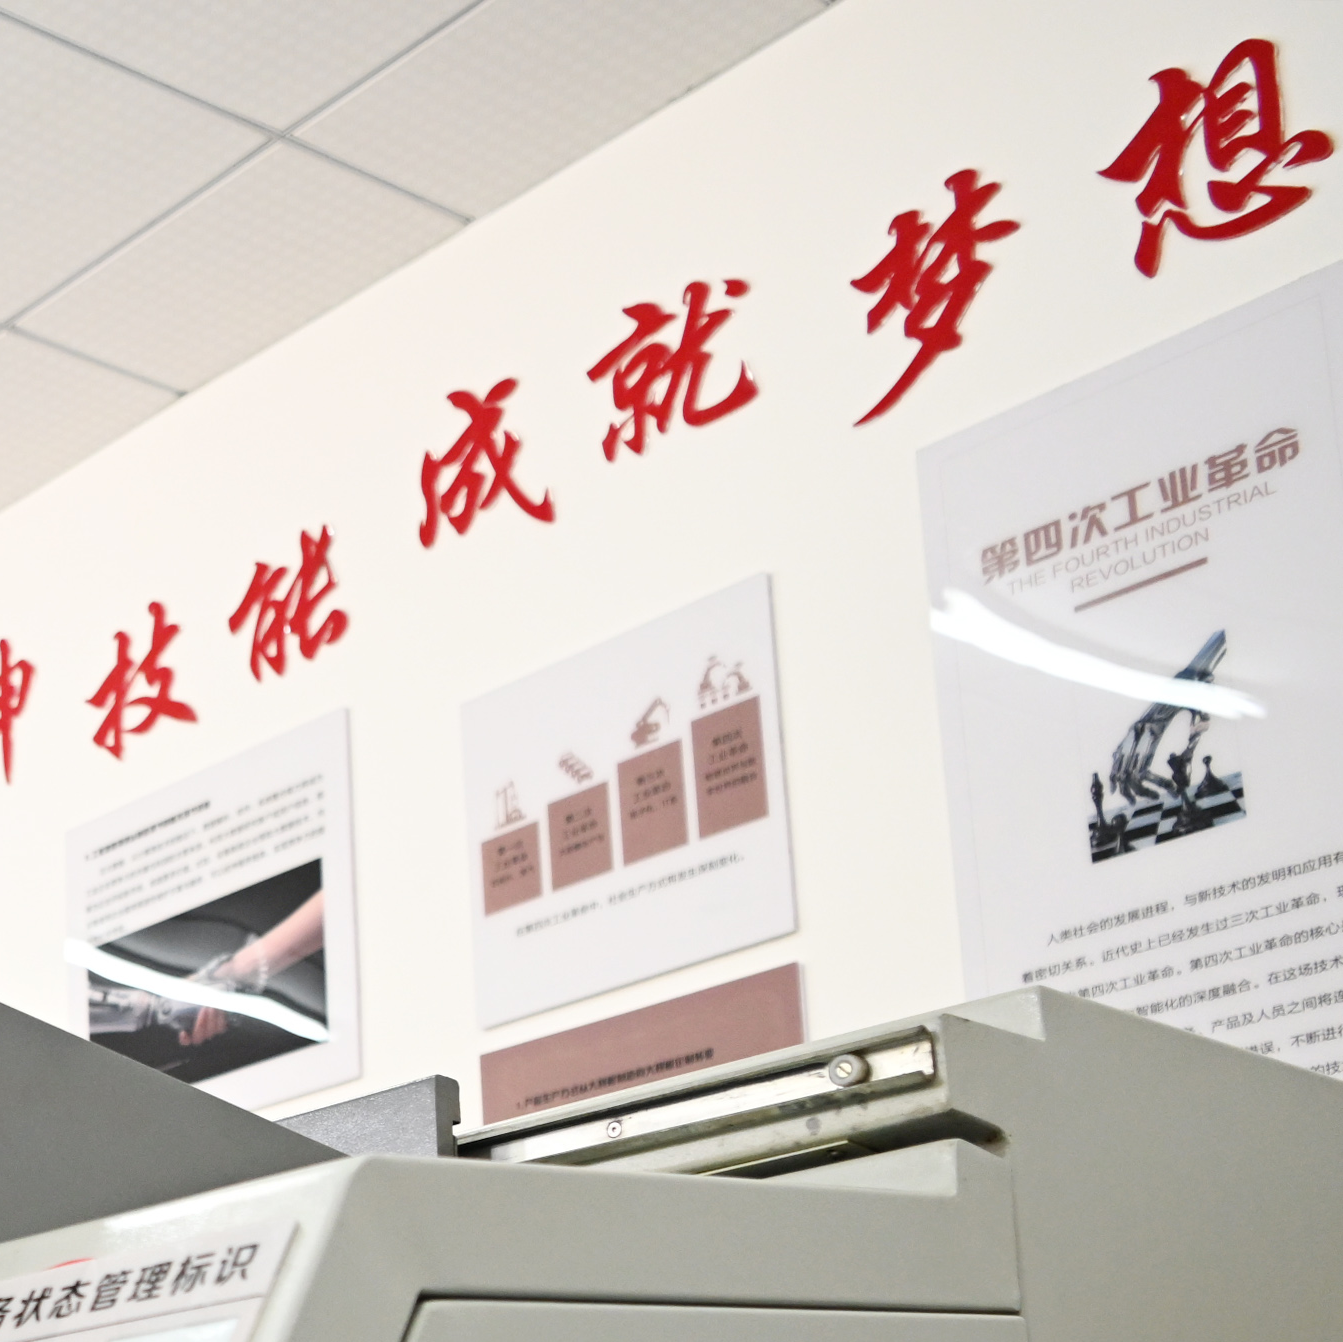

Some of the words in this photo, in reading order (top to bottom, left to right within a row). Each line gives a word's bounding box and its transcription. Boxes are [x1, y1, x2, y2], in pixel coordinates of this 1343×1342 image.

[980, 426, 1301, 586] 第四次工业革命
[1007, 571, 1047, 596] THE
[1052, 533, 1140, 580] FOURTH
[1144, 481, 1277, 543] INDUSTRIAL
[1070, 527, 1210, 593] REVOLUTION
